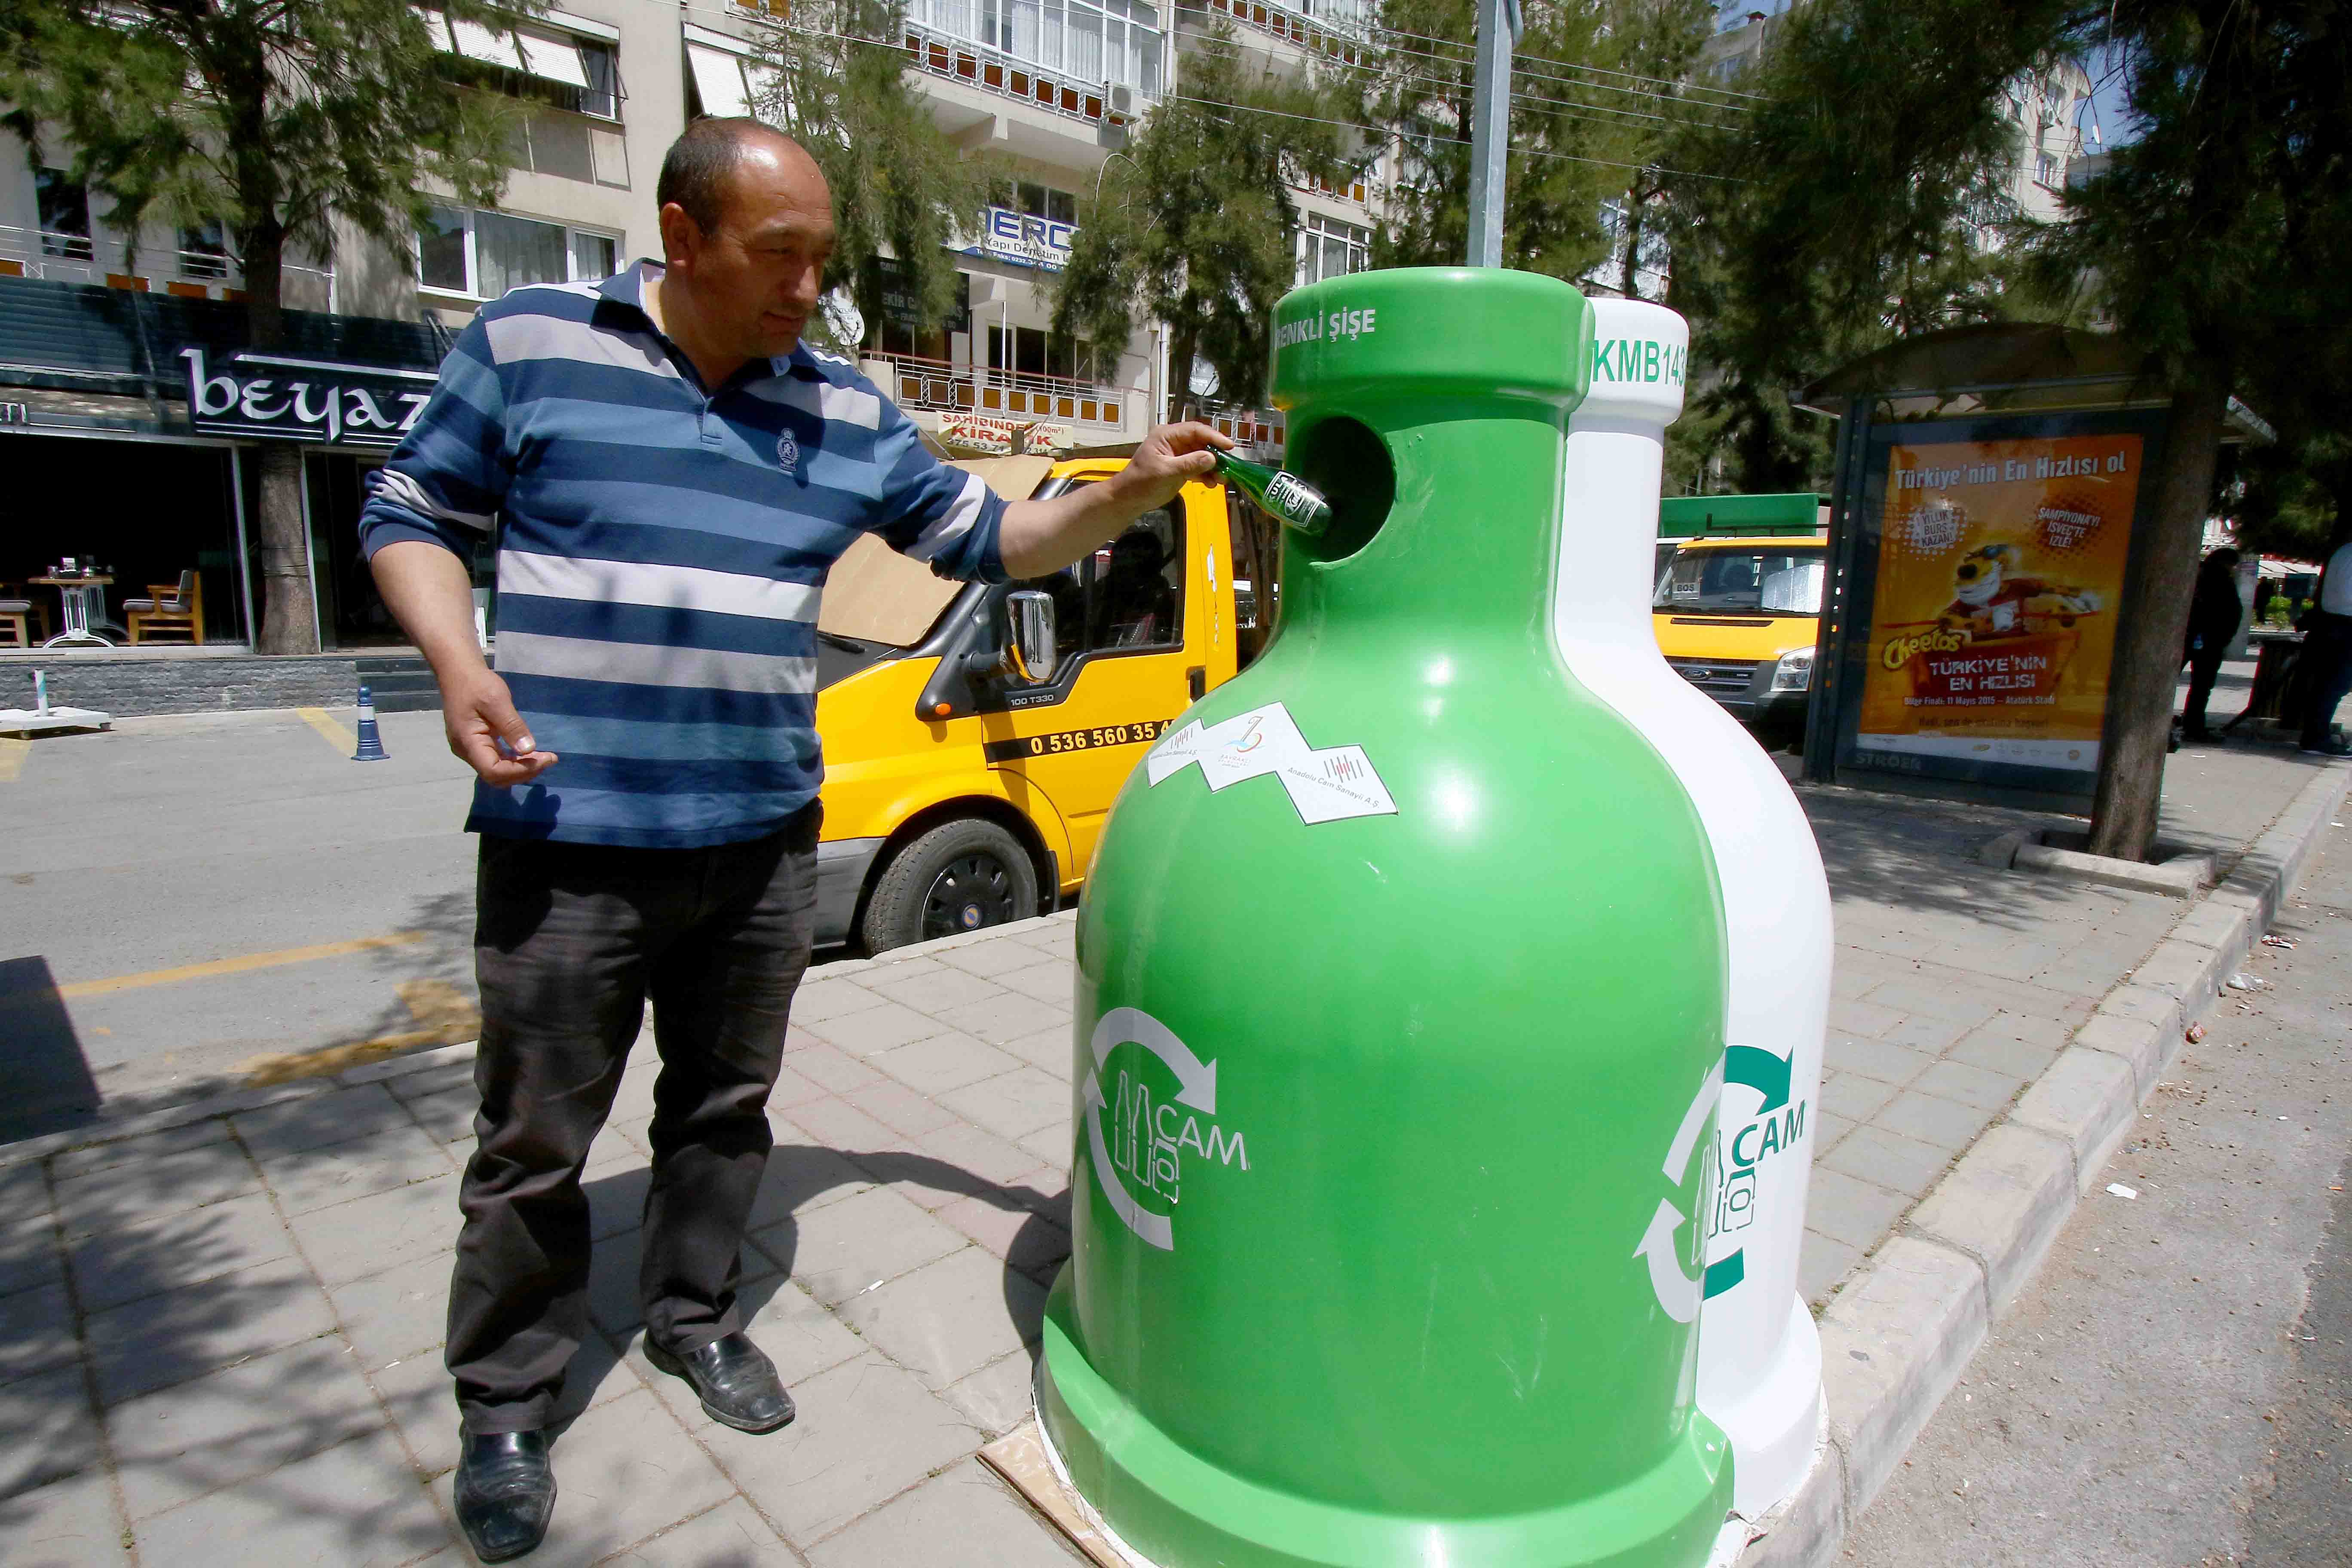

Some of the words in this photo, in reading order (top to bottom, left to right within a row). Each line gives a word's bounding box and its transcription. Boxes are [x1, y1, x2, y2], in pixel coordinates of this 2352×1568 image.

[1329, 306, 1375, 343] ŞİŞE
[973, 441, 987, 450] 53
[1896, 462, 1997, 491] Türkiye'nin
[2005, 459, 2027, 481] En
[2036, 455, 2098, 478] Hızlısı
[2107, 451, 2126, 473] ol
[1924, 523, 1948, 536] BURS
[1883, 628, 1963, 670] Cheetos
[1929, 652, 2047, 676] TÜRKİYE'NİN
[1949, 677, 1972, 691] EN
[1011, 698, 1027, 706] 100
[1030, 695, 1054, 704] T330
[1978, 696, 1995, 704] 2015
[1031, 737, 1043, 754] 0
[1050, 732, 1087, 752] 536
[1092, 727, 1127, 746] 560
[1133, 723, 1155, 740] 35
[1161, 720, 1175, 735] 4
[1287, 767, 1316, 781] Anadolu
[1318, 777, 1334, 788] Cam
[1156, 1104, 1247, 1170] CAM
[1731, 1099, 1806, 1168] CAM
